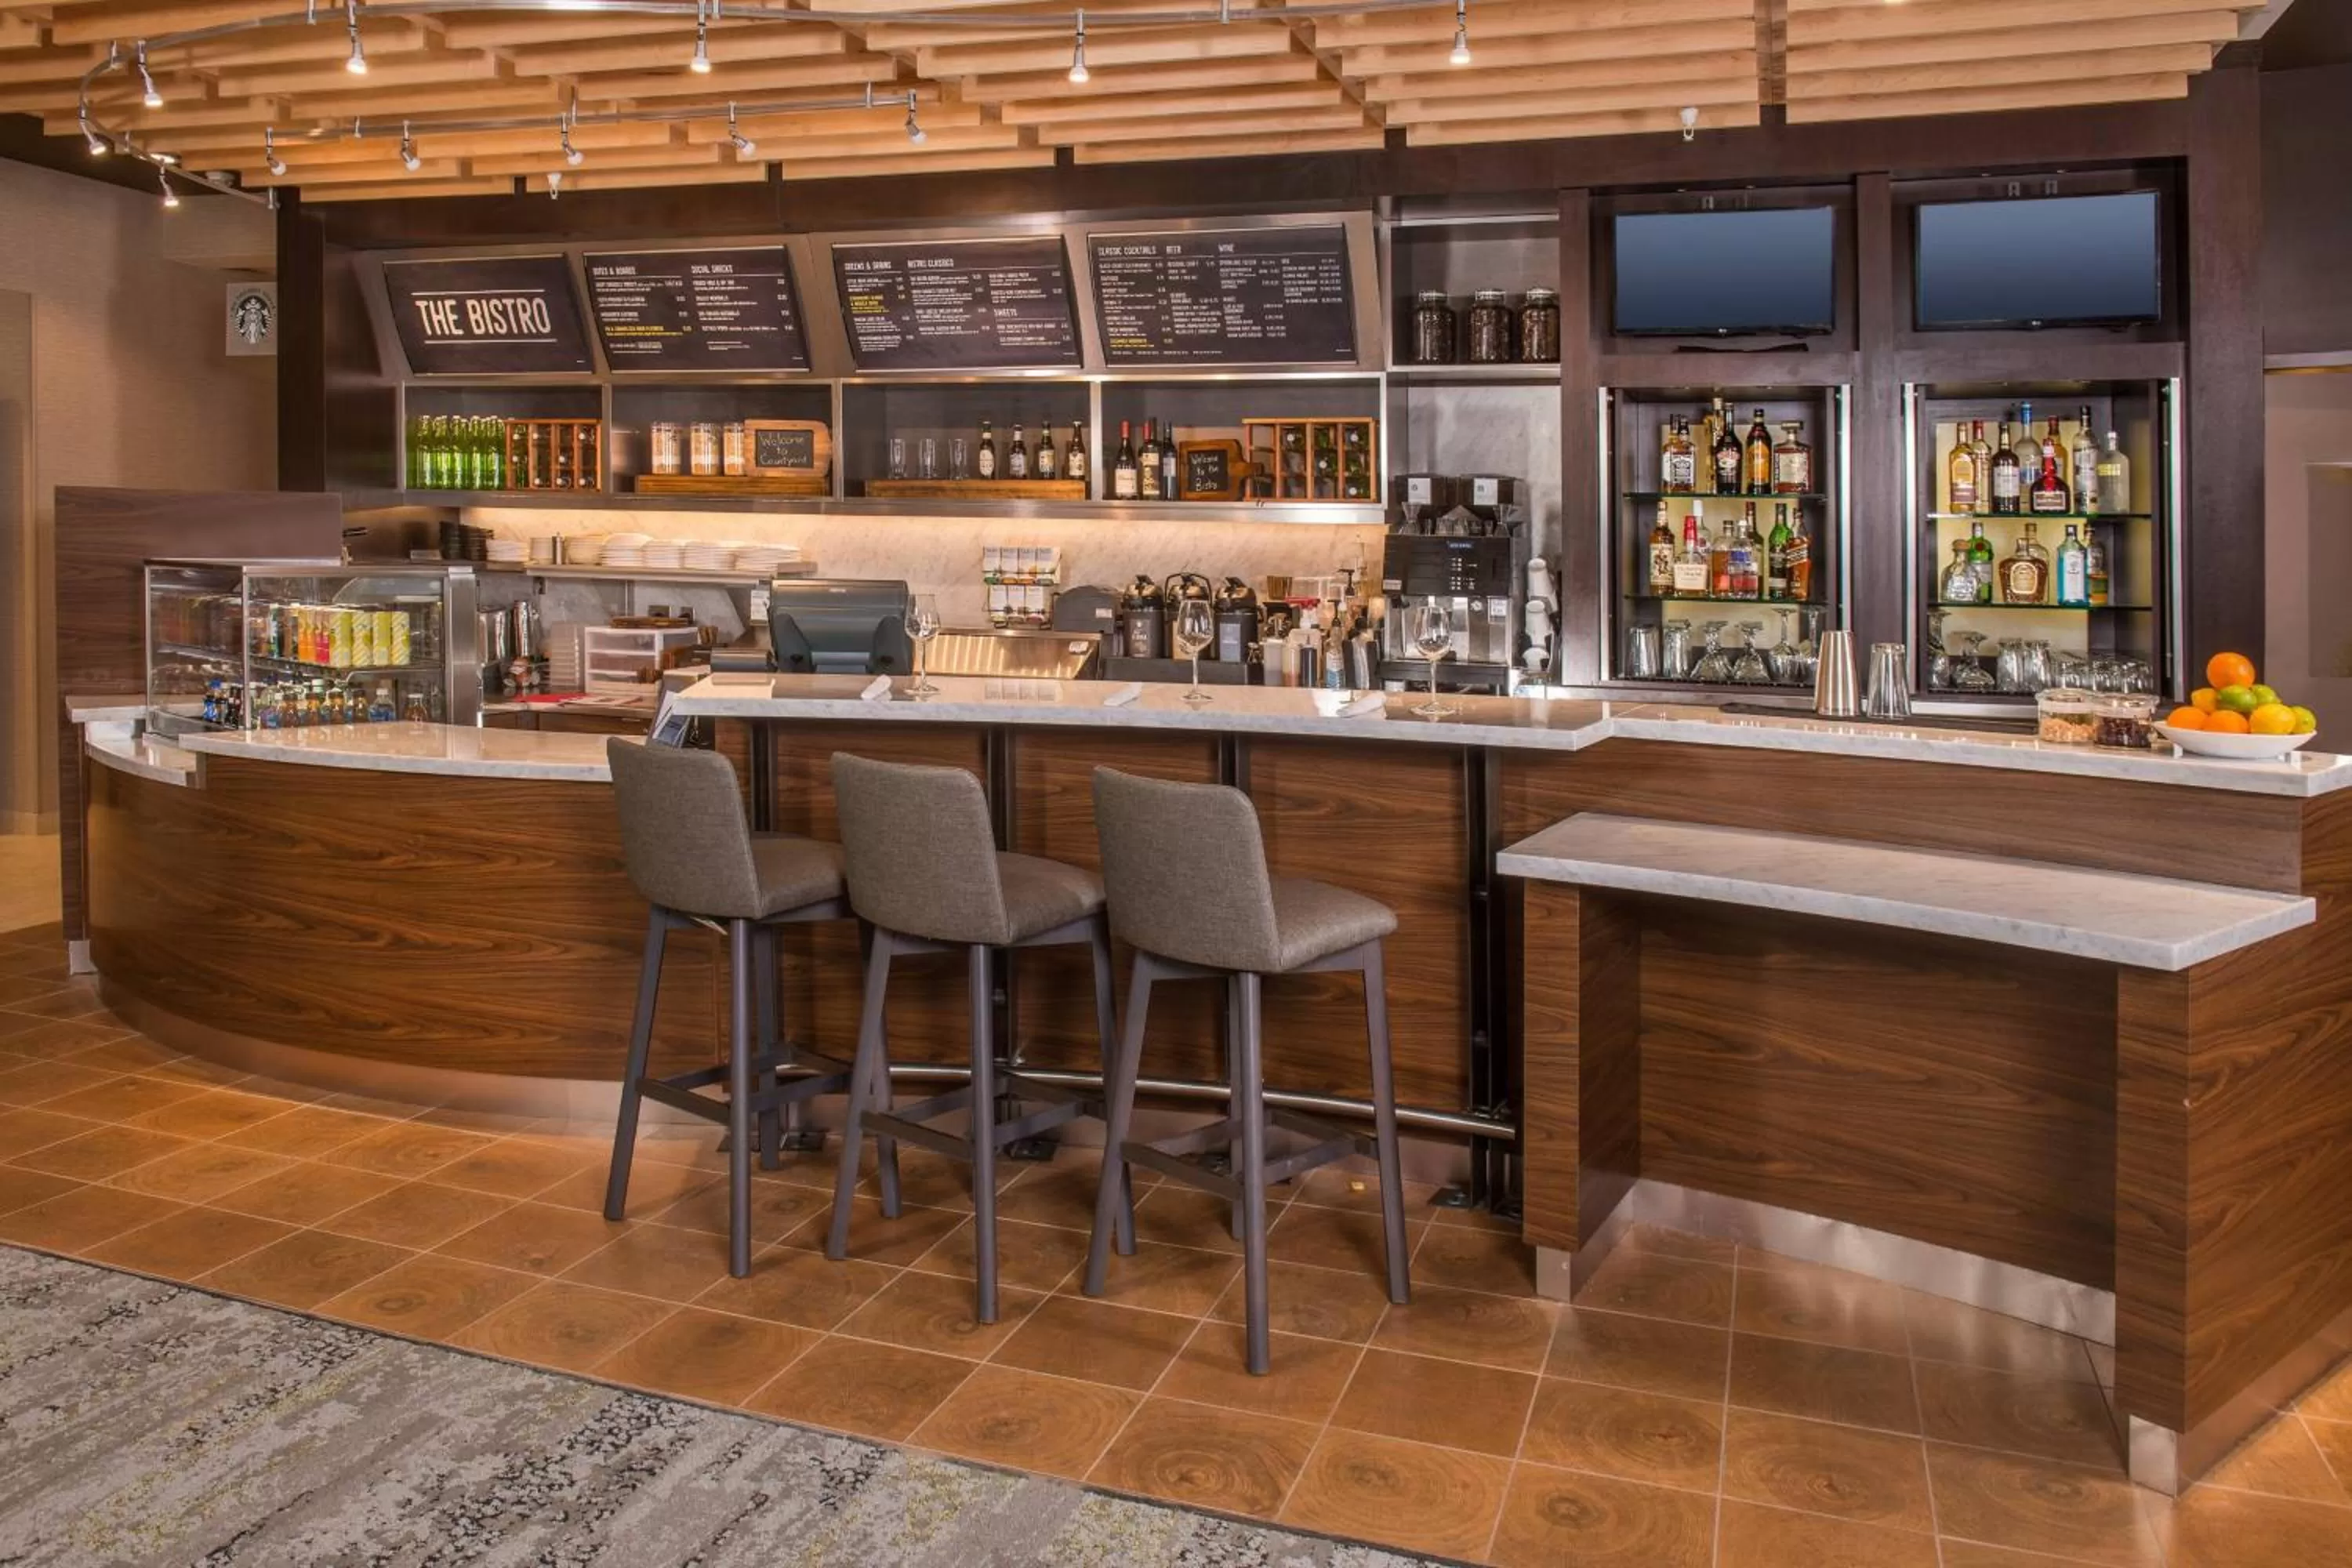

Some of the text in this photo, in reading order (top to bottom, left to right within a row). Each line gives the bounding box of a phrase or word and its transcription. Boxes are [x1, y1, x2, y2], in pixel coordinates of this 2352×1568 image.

[1098, 245, 1156, 256] CLASSIC COCKTAILS
[415, 297, 551, 336] THE BISTRO
[993, 308, 1018, 318] SWEETS
[759, 431, 804, 446] Welcome
[776, 446, 788, 456] to
[760, 453, 807, 466] Courtyard
